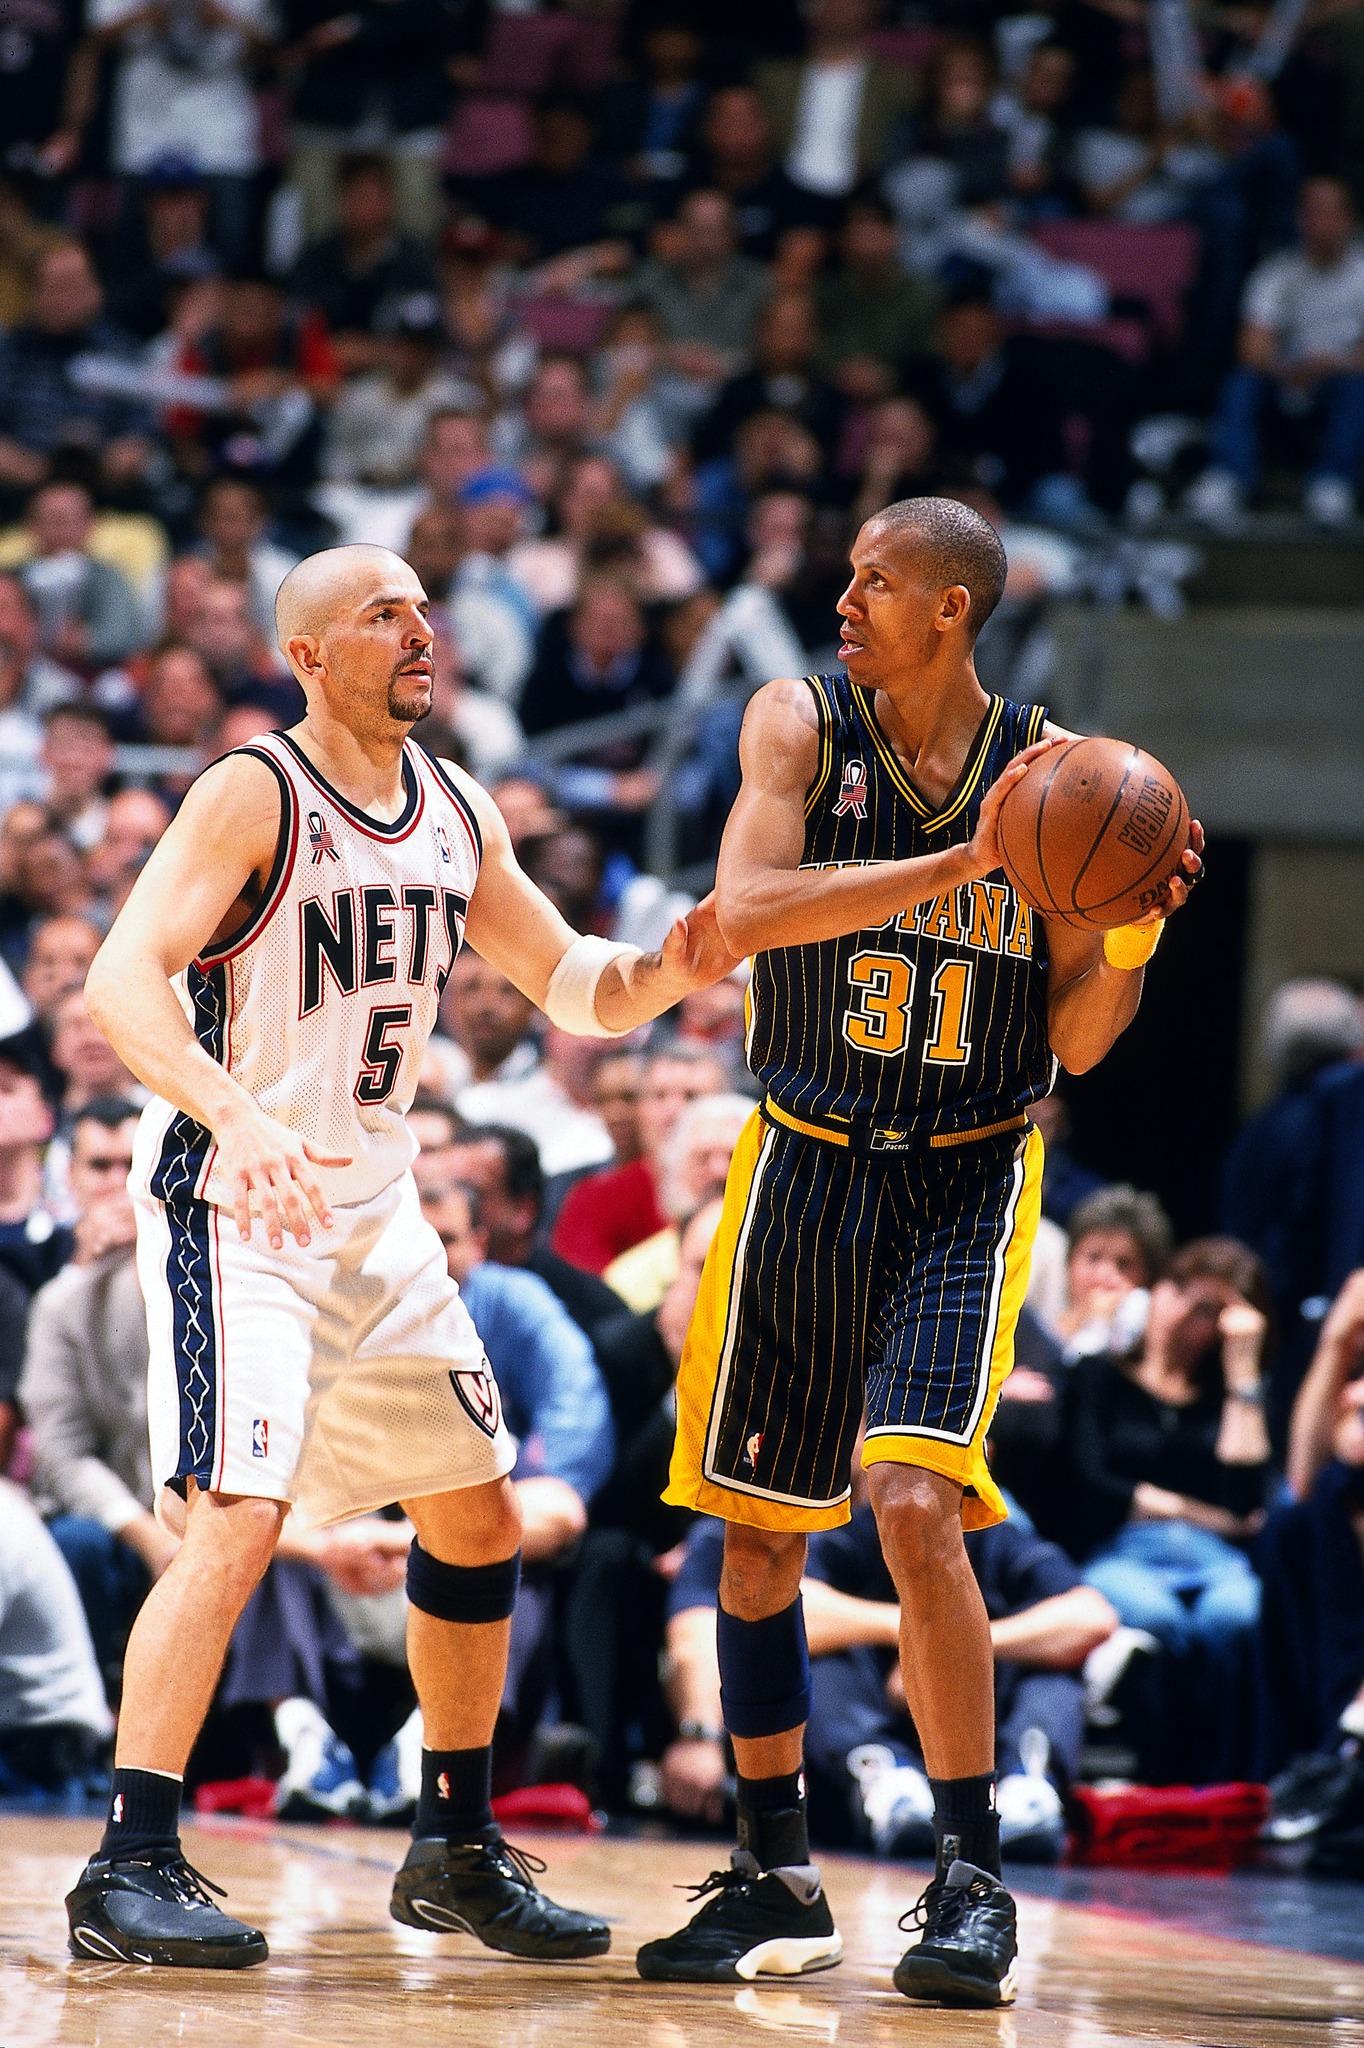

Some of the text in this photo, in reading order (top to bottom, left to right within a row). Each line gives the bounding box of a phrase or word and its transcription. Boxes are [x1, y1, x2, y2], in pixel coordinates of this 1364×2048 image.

[1118, 787, 1170, 857] NBA
[298, 883, 469, 1021] NETS
[353, 1003, 412, 1107] 5
[842, 949, 973, 1066] 31
